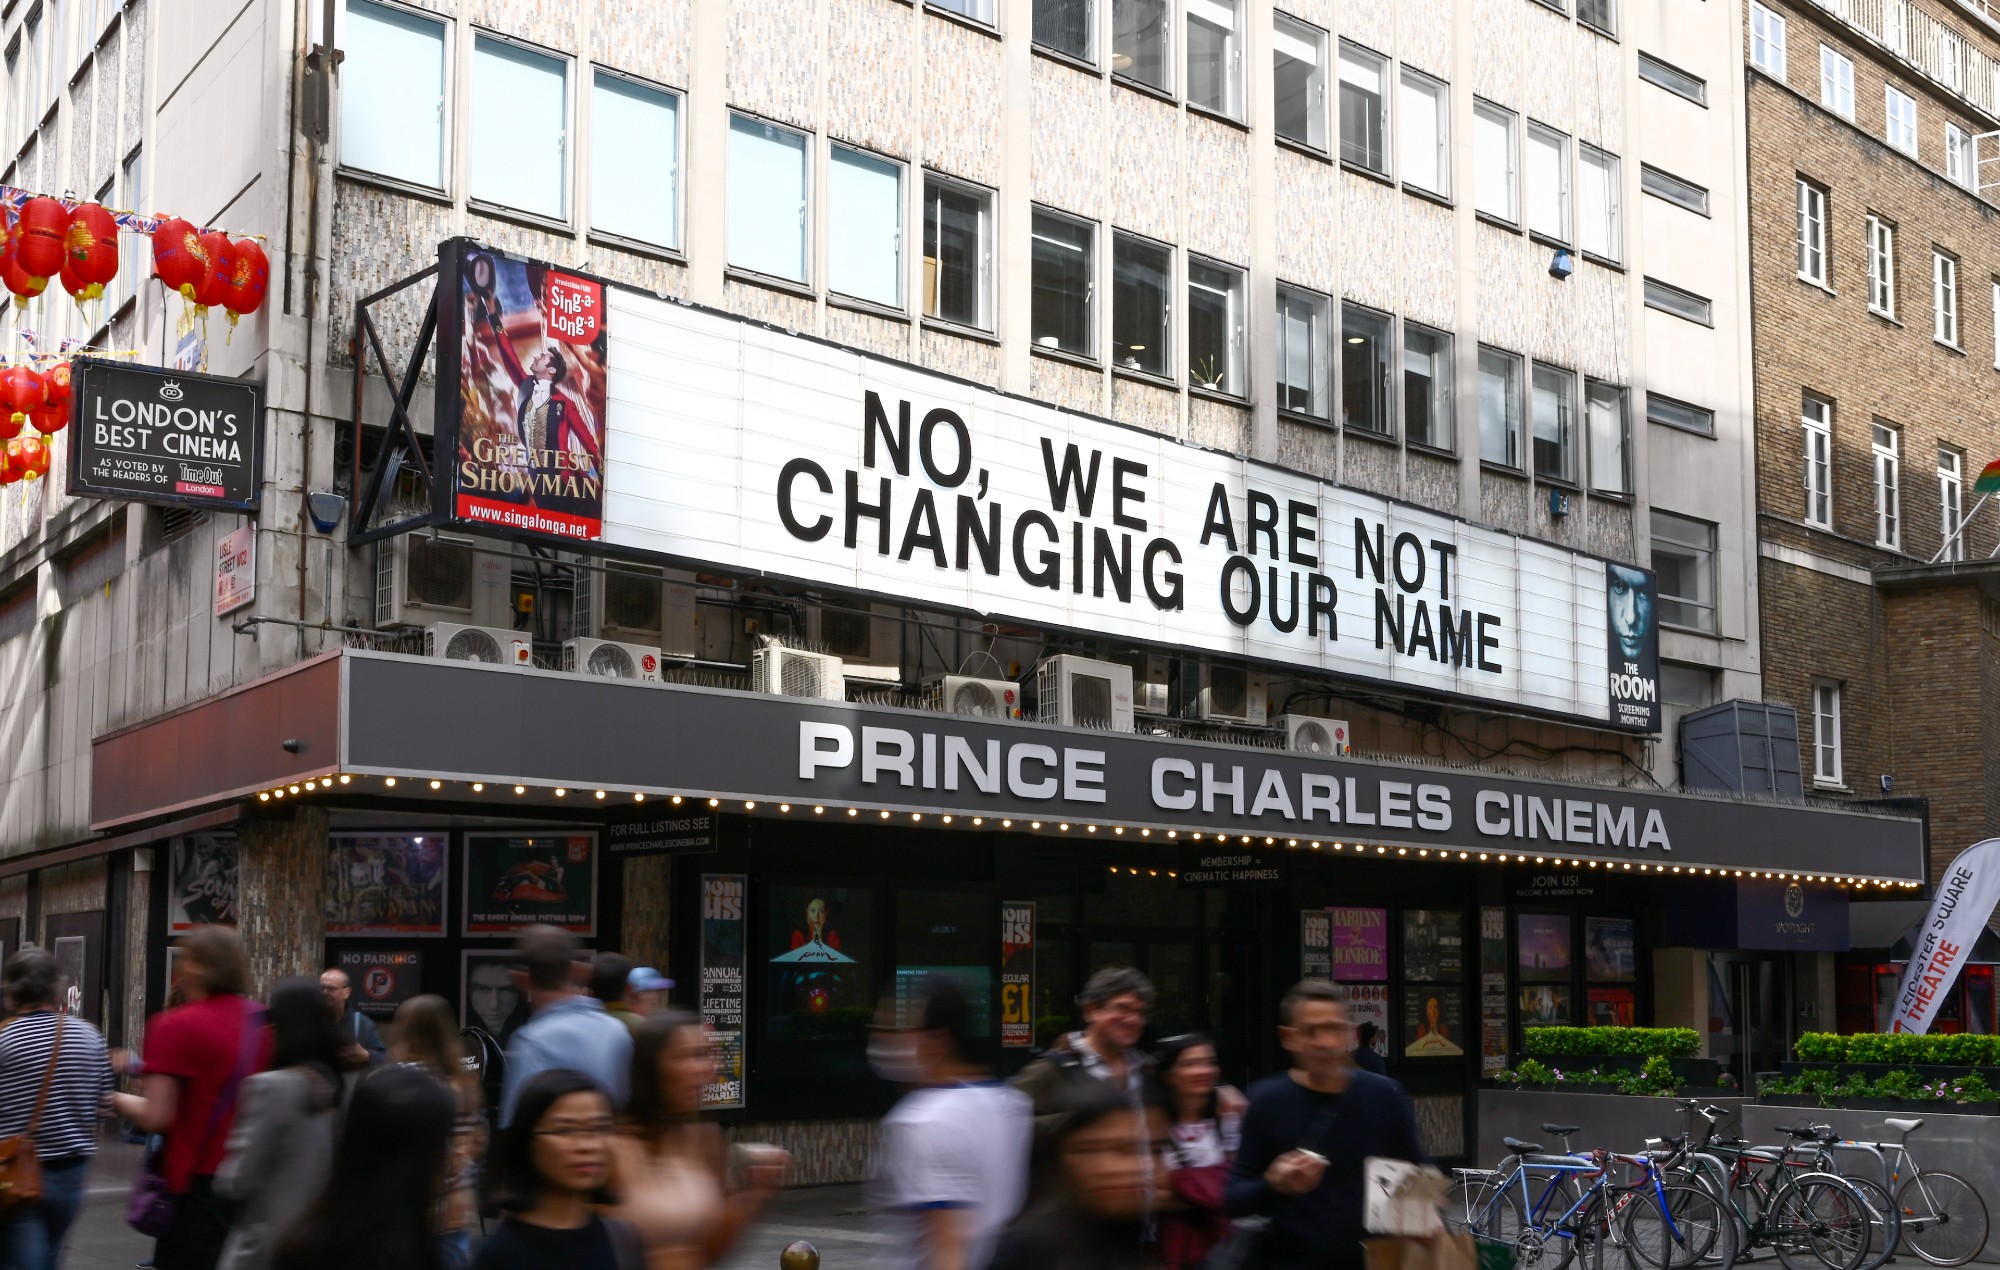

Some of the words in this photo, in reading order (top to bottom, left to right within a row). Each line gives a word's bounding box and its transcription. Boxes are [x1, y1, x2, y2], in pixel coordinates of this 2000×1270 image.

[552, 308, 594, 336] Long-a
[96, 396, 237, 436] LONDON'S
[95, 424, 152, 450] BEST
[163, 433, 241, 462] CINEMA
[496, 432, 518, 445] THE
[473, 437, 594, 472] GREATEST
[93, 467, 110, 477] THE
[113, 470, 150, 482] READERS
[156, 475, 168, 484] OF
[100, 458, 112, 467] AS
[116, 460, 148, 472] VOTED
[152, 464, 164, 474] BY
[186, 484, 214, 494] London
[460, 461, 598, 500] SHOWMAN
[864, 390, 989, 500] NO,
[1040, 437, 1148, 532] WE
[1200, 482, 1318, 568] ARE
[1354, 517, 1457, 600] NOT
[470, 504, 587, 538] www.singalonga.net
[219, 556, 235, 577] STREET
[777, 458, 1184, 611] CHANGING
[1221, 556, 1338, 642] OUR
[1376, 588, 1502, 674] NAME
[1624, 662, 1638, 675] THE
[1610, 673, 1656, 702] ROOM
[1618, 703, 1650, 716] SCREENING
[1620, 715, 1648, 727] MONTHLY
[799, 721, 1106, 803] PRINCE
[1151, 757, 1452, 831] CHARLES
[1475, 790, 1671, 851] CINEMA
[611, 824, 627, 836] FOR
[629, 822, 649, 835] FULL
[652, 818, 690, 834] LISTINGS
[693, 817, 710, 830] SEE
[610, 836, 710, 852] WWW.PRINCECHARLESCINEMA.COM
[1200, 856, 1251, 867] MEMBERSHIP
[1184, 870, 1229, 882] CINEMATIC
[1232, 869, 1279, 880] HAPPINESS
[1531, 876, 1557, 887] JOIN
[1562, 875, 1579, 886] US!
[181, 878, 240, 906] SOUN
[1551, 888, 1575, 896] MEMBER
[1901, 932, 1938, 1014] LEICESTER
[1932, 866, 1973, 930] SQUARE
[343, 954, 360, 964] NO
[363, 954, 416, 964] PARKING
[704, 968, 742, 979] ANNUAL
[1906, 939, 1960, 1022] THEATRE
